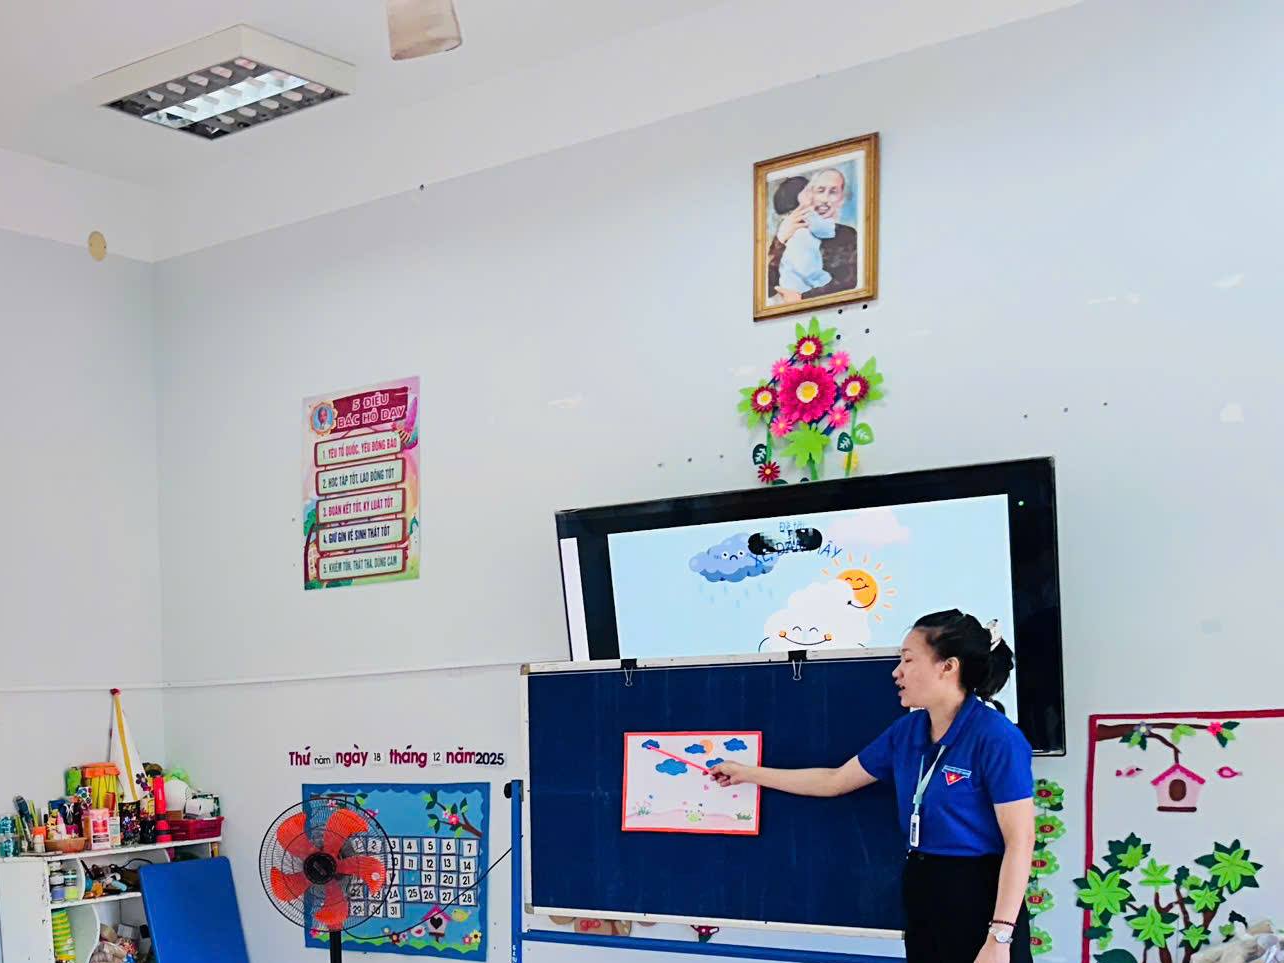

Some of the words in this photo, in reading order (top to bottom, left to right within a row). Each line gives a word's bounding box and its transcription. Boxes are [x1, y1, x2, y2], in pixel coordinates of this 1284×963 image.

[352, 399, 360, 411] 5
[363, 392, 390, 409] ĐIỀU
[337, 412, 360, 428] BÁC
[362, 408, 378, 424] HỒ
[381, 405, 406, 421] DẠY
[385, 466, 394, 479] TỐT
[384, 496, 393, 509] TỐT
[354, 528, 366, 541] SINH
[381, 525, 390, 537] TỐT
[288, 746, 311, 766] Thứ
[314, 755, 331, 765] năm
[335, 744, 368, 768] ngày
[373, 752, 381, 762] 18
[389, 744, 427, 768] tháng
[433, 752, 440, 762] 12
[446, 747, 475, 765] năm
[475, 752, 505, 765] 2025
[407, 841, 412, 850] 4
[428, 841, 433, 850] 5
[446, 841, 451, 850] 6
[467, 843, 473, 853] 7
[408, 859, 414, 868] 11
[427, 860, 433, 869] 12
[444, 859, 451, 868] 13
[463, 861, 471, 871] 14
[424, 874, 432, 883] 19
[443, 875, 453, 884] 20
[462, 875, 470, 884] 21
[389, 890, 398, 899] 24
[408, 888, 418, 898] 25
[423, 890, 433, 899] 26
[442, 892, 451, 901] 27
[462, 894, 472, 903] 28
[352, 906, 361, 914] 29
[390, 907, 397, 915] 31
